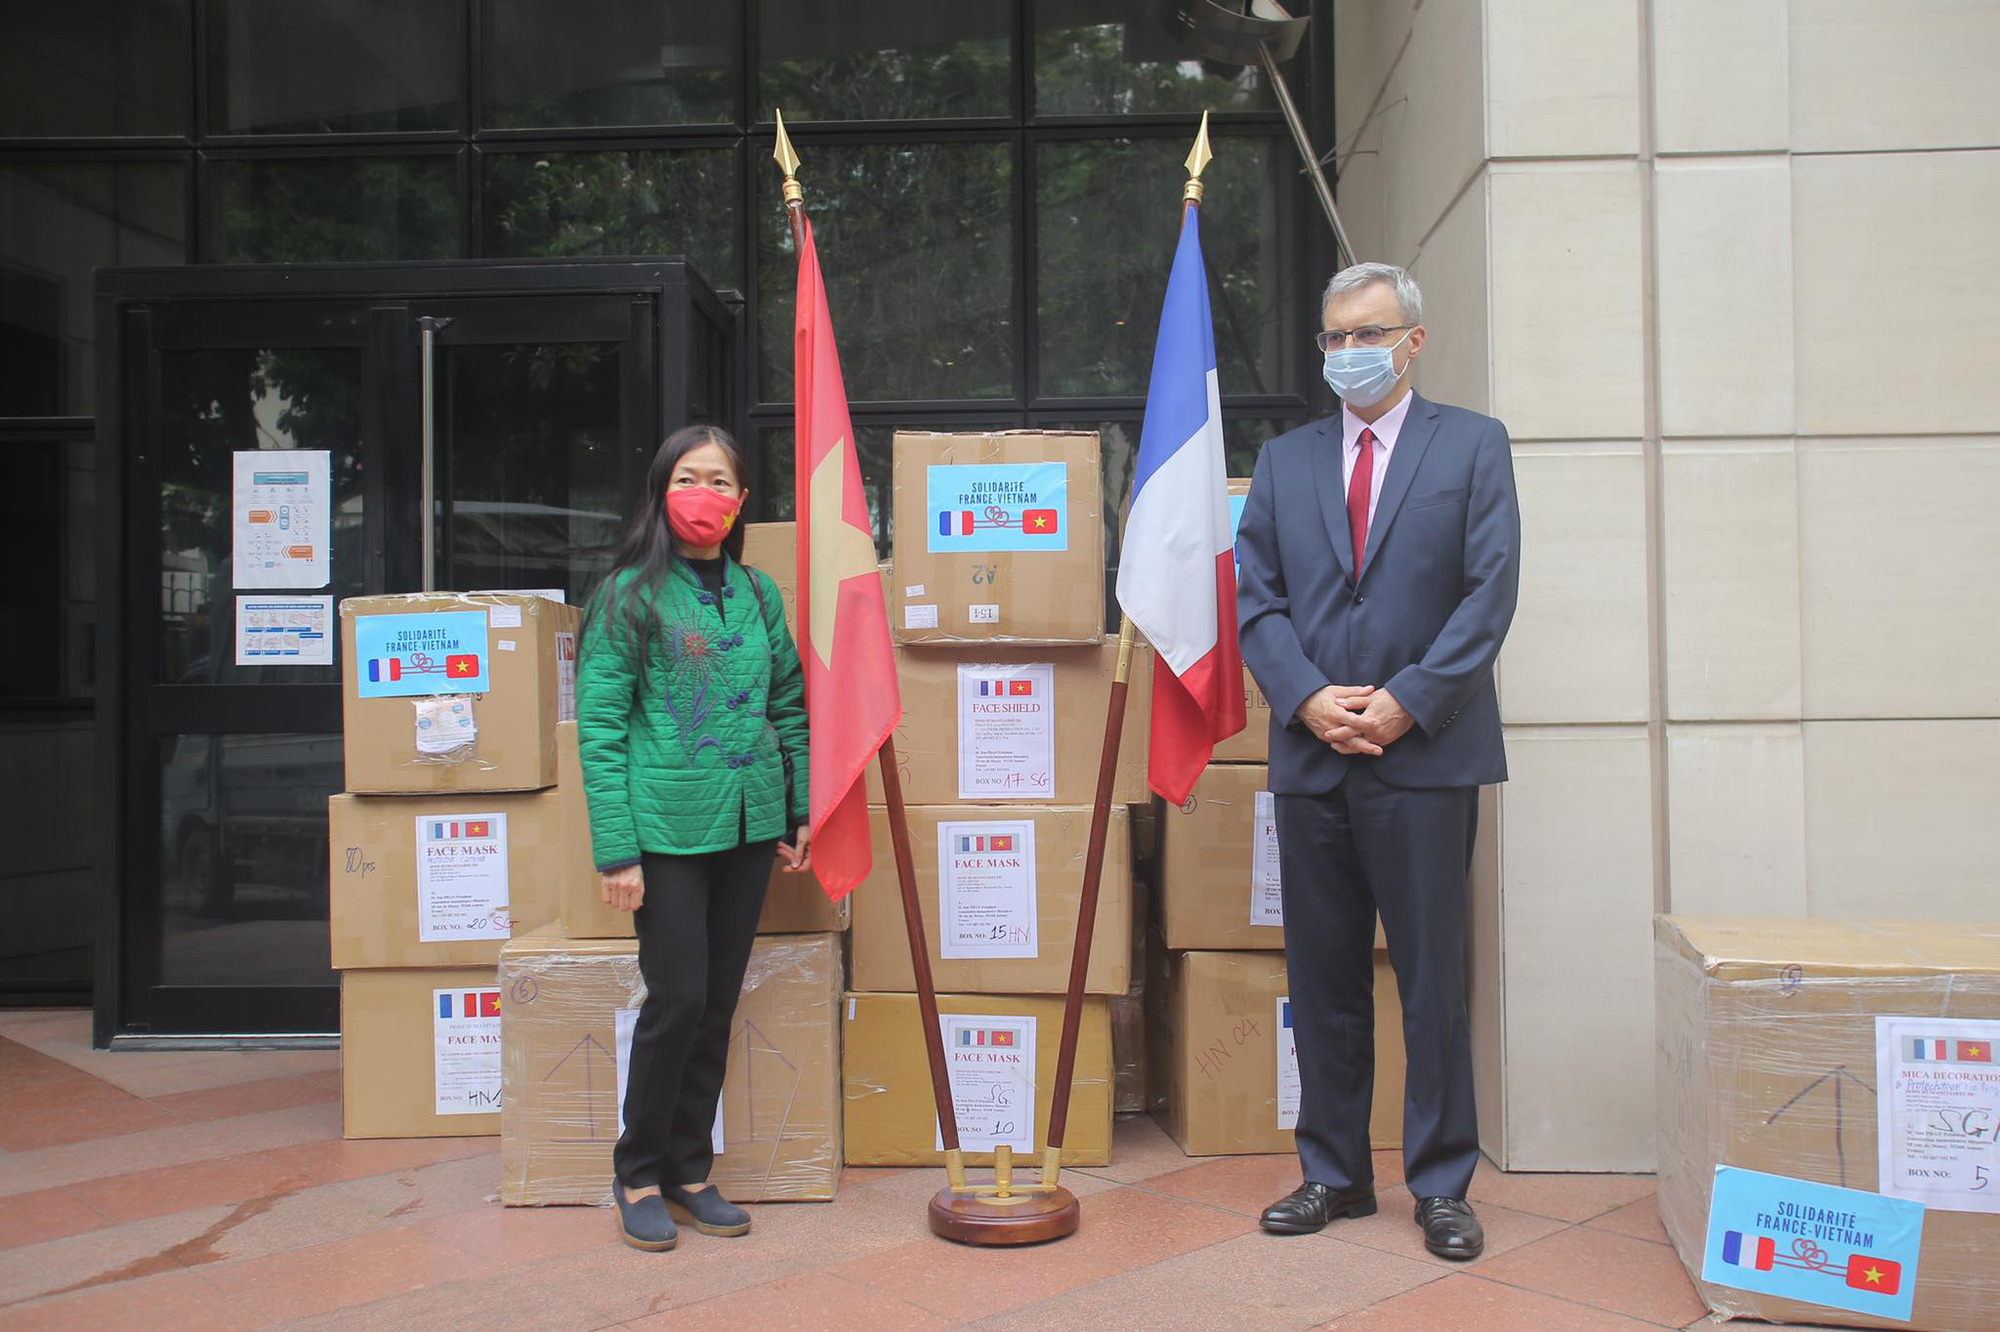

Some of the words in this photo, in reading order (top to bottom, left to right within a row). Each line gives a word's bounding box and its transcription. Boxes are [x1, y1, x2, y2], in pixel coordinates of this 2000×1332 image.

[959, 493, 1037, 504] FRANCE-VIETNAM
[386, 640, 459, 652] FRANCE-VIETNAM
[972, 703, 1001, 713] FACE
[1002, 703, 1041, 713] SHIELD
[1003, 773, 1025, 788] 17
[1031, 772, 1050, 787] SG
[427, 846, 458, 856] FACE
[461, 845, 498, 855] MASK
[954, 858, 984, 869] FACE
[986, 858, 1021, 868] MASK
[467, 918, 487, 929] 20
[989, 924, 1007, 940] 15
[1008, 925, 1031, 943] HN
[448, 1035, 477, 1045] FACE
[954, 1053, 984, 1063] FACE
[986, 1053, 1021, 1063] MASK
[1195, 1037, 1232, 1080] HN
[1901, 1070, 1930, 1079] MICA
[983, 1084, 1015, 1105] SG
[990, 1120, 1014, 1136] 10
[1908, 1168, 1930, 1178] BOX
[1933, 1170, 1952, 1179] NO:
[1969, 1165, 1989, 1191] 5
[1778, 1201, 1857, 1229] SOLIDARITÉ
[1756, 1213, 1874, 1248] FRANCE-VIETNAM
